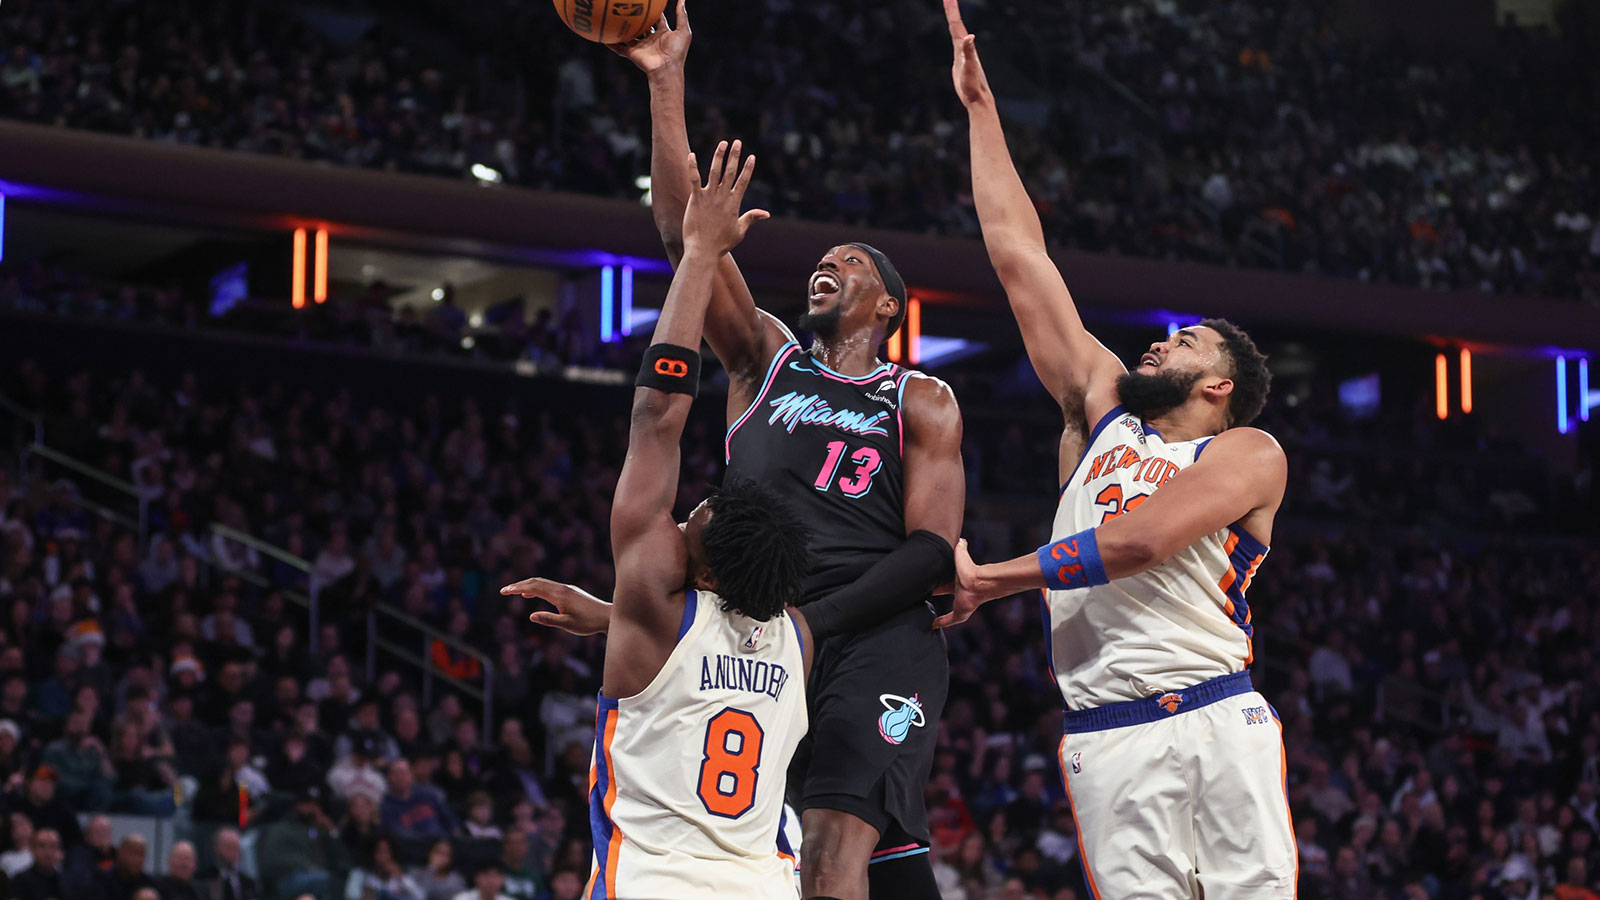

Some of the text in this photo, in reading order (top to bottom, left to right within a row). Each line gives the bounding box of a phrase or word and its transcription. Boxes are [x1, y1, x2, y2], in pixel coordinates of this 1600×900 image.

[768, 391, 890, 437] Miami
[814, 441, 883, 499] 13
[1083, 444, 1180, 488] NEW YOR
[1051, 539, 1083, 584] 32
[696, 706, 765, 820] 8
